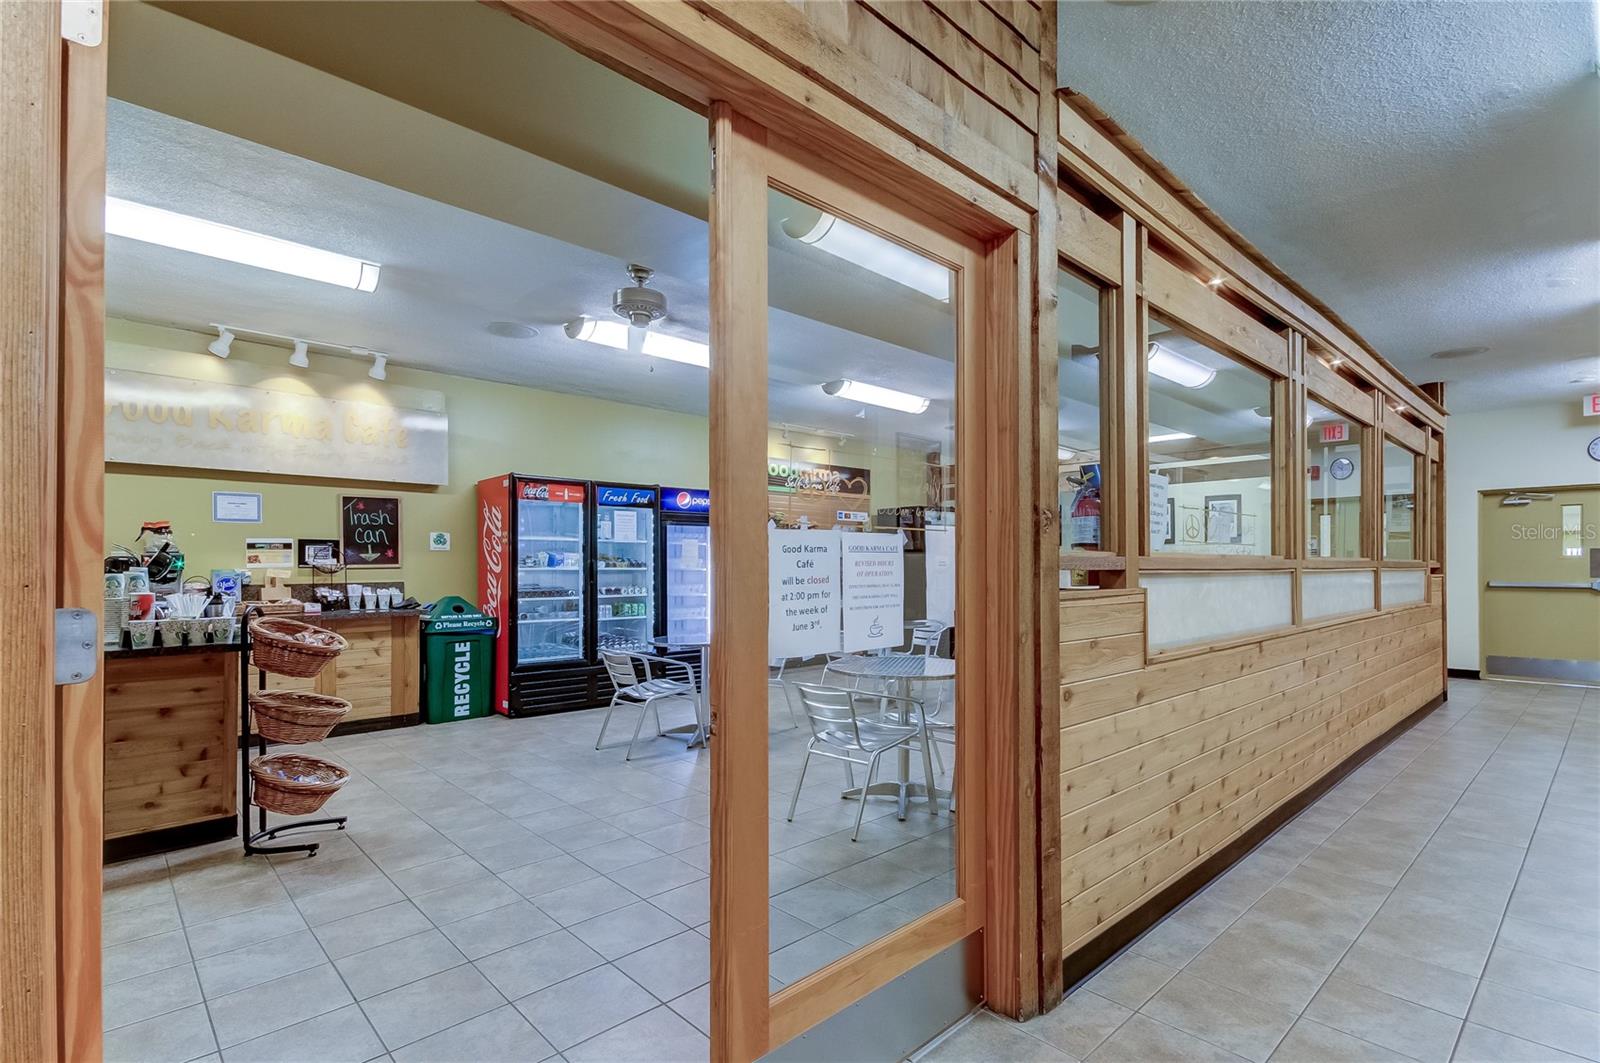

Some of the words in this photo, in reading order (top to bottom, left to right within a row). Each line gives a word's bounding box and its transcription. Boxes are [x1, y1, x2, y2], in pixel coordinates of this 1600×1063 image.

[104, 398, 193, 428] ood
[602, 490, 628, 503] Fresh
[630, 492, 651, 505] Food
[692, 497, 710, 507] peps
[344, 498, 395, 526] Trash
[782, 544, 802, 554] Good
[803, 544, 828, 553] Karma
[482, 499, 503, 638] oca-Cola
[796, 559, 815, 569] Café
[782, 576, 794, 586] will
[795, 576, 805, 585] be
[806, 575, 830, 585] closed
[781, 593, 788, 601] at
[789, 591, 806, 601] 2:00
[806, 592, 820, 602] pm
[821, 590, 831, 599] for
[785, 608, 798, 617] the
[799, 606, 819, 615] week
[820, 604, 828, 614] of
[463, 620, 486, 628] Recycle
[792, 623, 808, 632] June
[454, 641, 471, 717] RECYCLE
